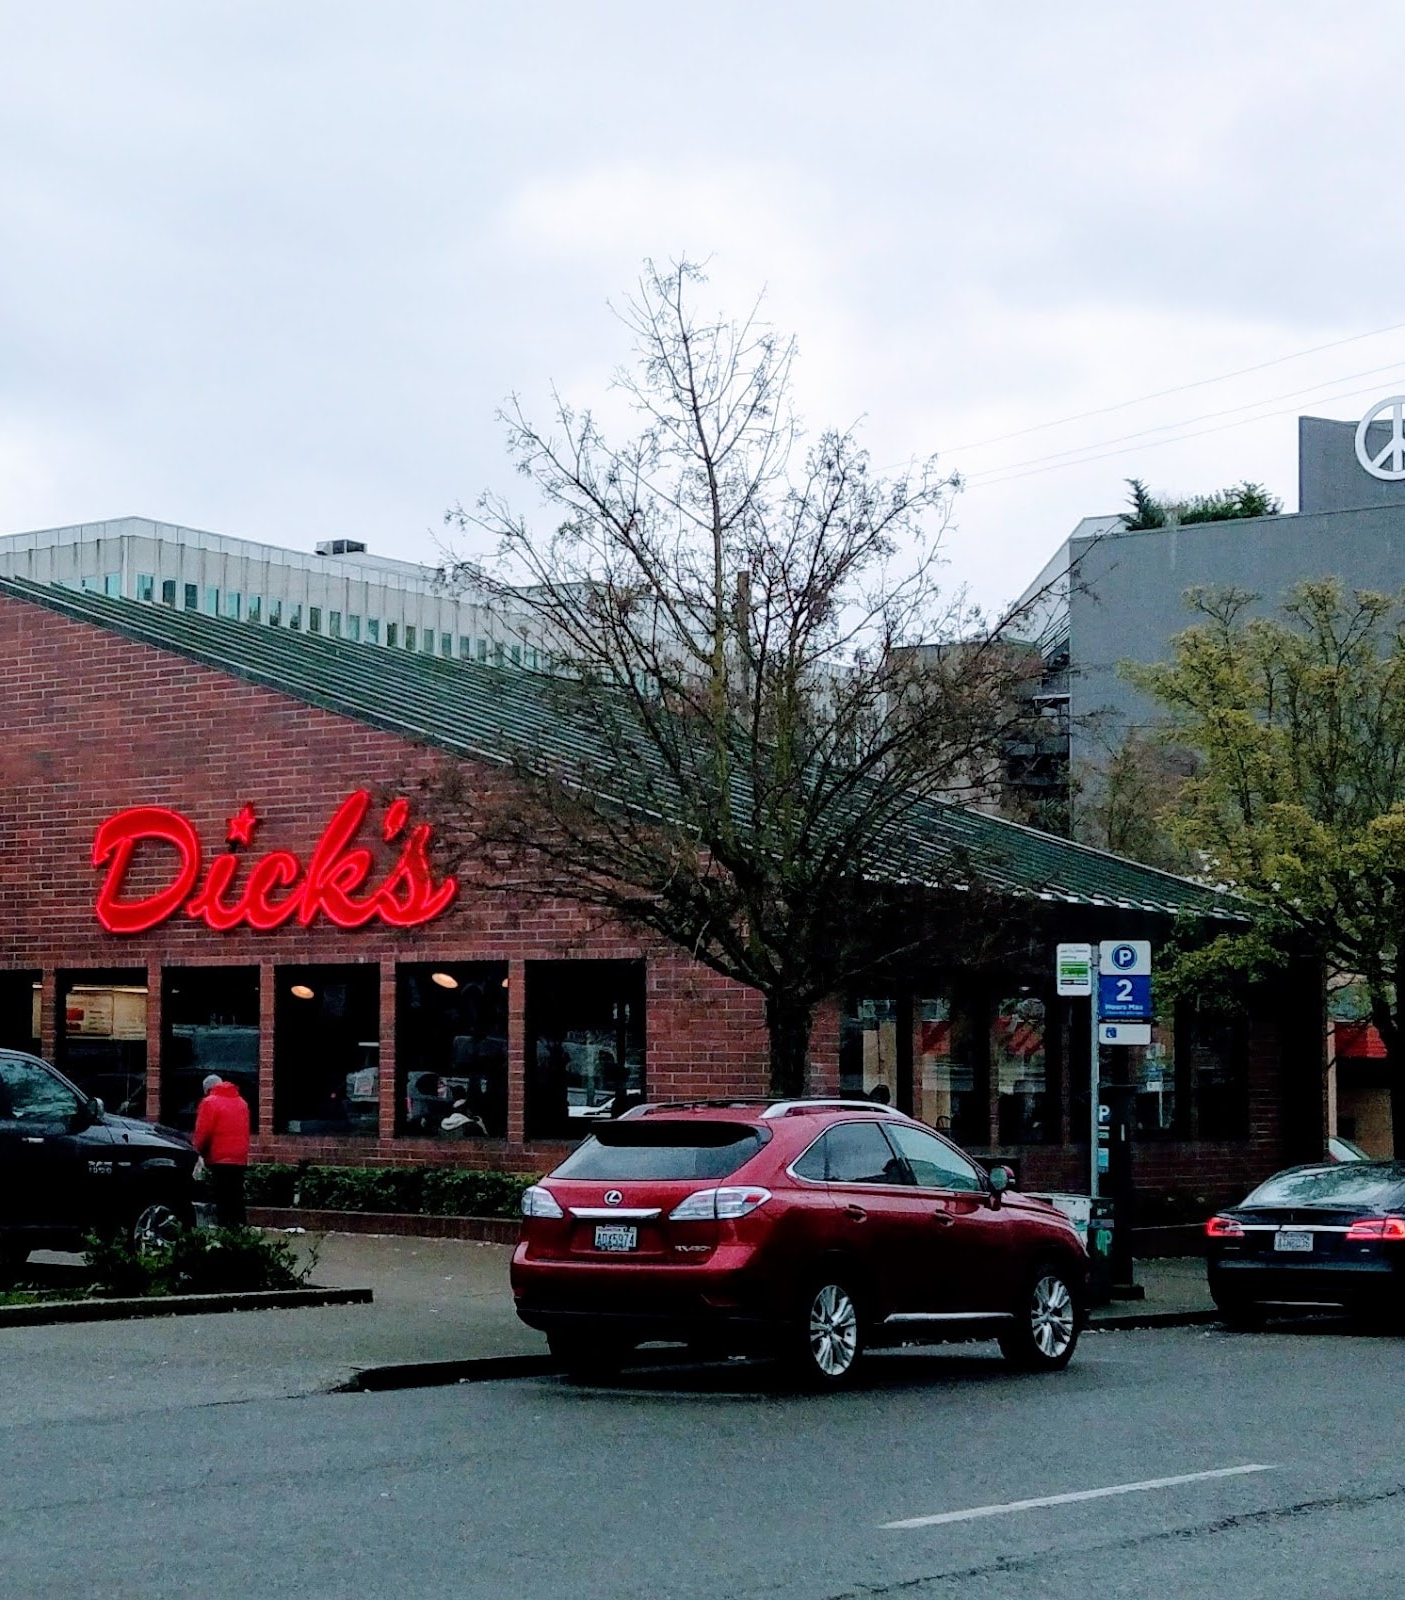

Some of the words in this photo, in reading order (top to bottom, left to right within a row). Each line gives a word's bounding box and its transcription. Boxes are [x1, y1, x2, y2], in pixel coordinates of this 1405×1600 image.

[92, 788, 458, 935] Dick's
[1118, 949, 1132, 966] P
[1116, 979, 1133, 1002] 2
